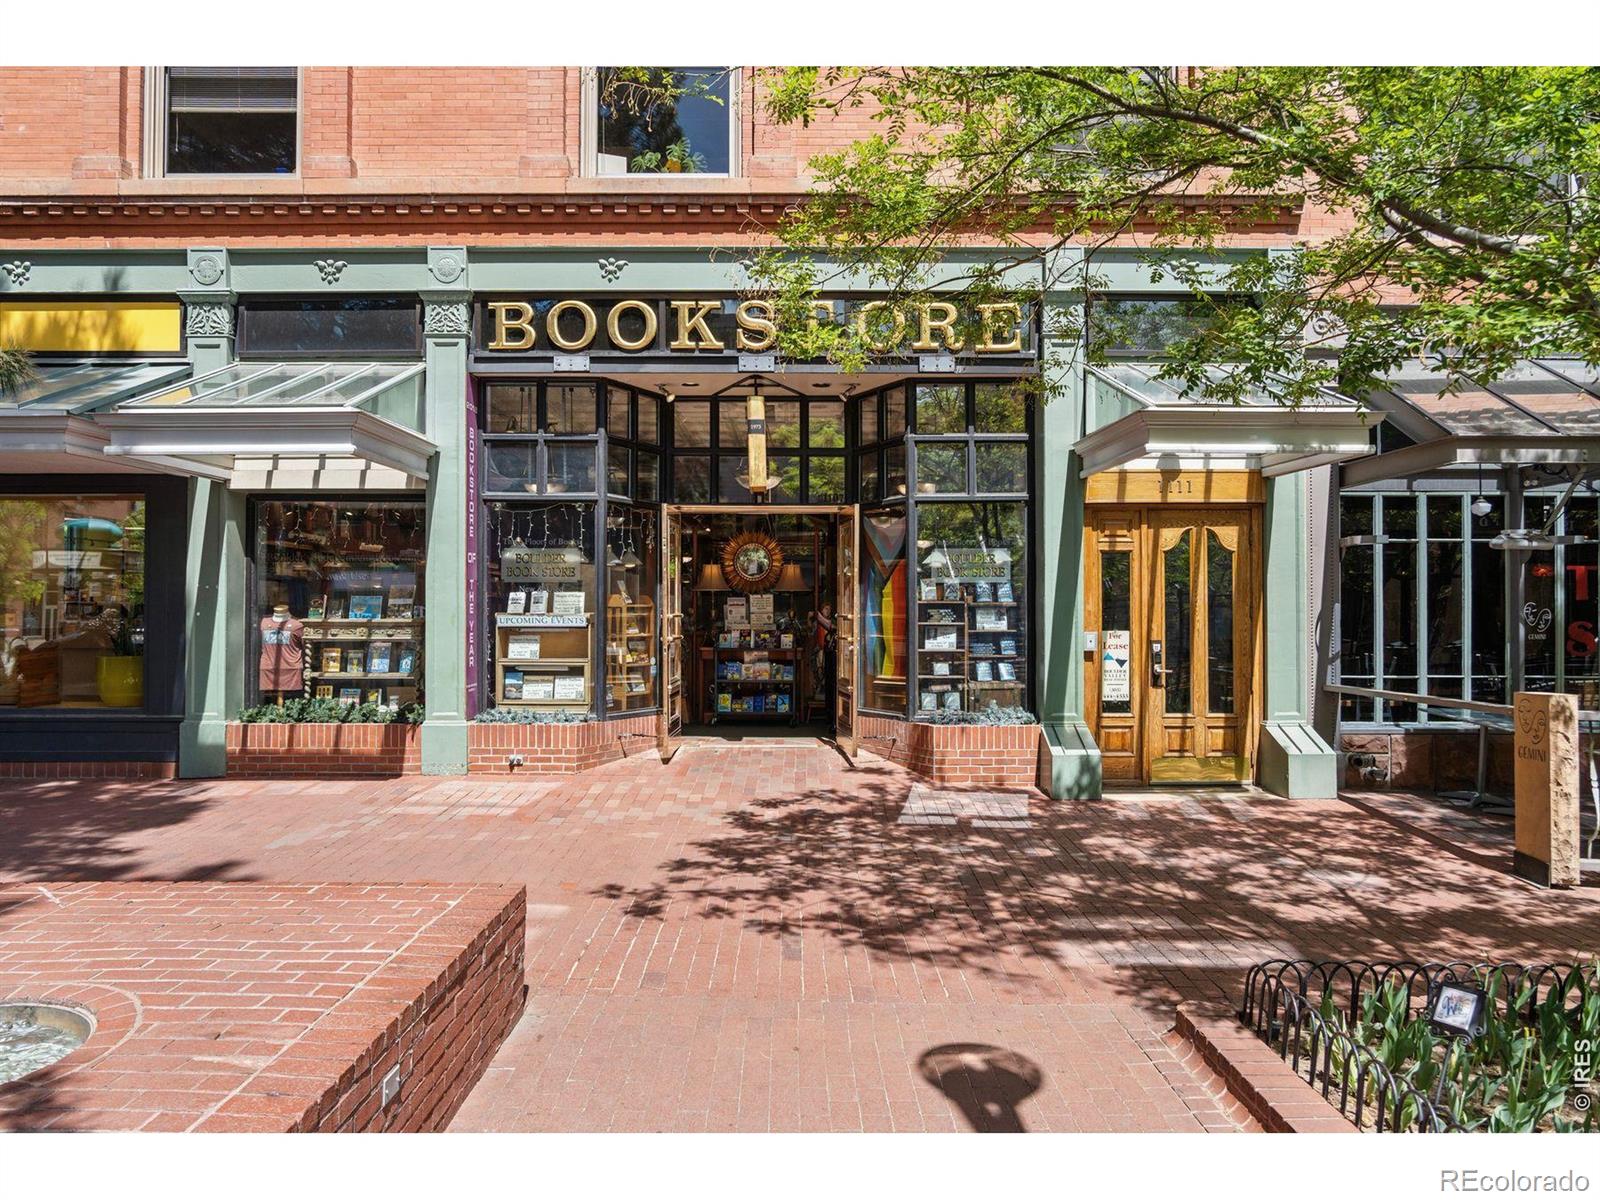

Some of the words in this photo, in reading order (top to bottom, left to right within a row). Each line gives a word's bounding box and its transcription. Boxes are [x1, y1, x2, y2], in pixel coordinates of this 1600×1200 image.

[1157, 480, 1192, 494] 1111
[467, 552, 476, 563] OF
[515, 553, 567, 564] BOULDER
[506, 567, 539, 577] BOOK
[541, 567, 576, 577] STORE
[972, 567, 1006, 577] STORE
[498, 616, 548, 625] UPCOMING
[550, 616, 584, 625] EVENTS
[1108, 632, 1122, 640] For
[1102, 641, 1129, 650] Lease
[1518, 746, 1546, 762] GEMINI
